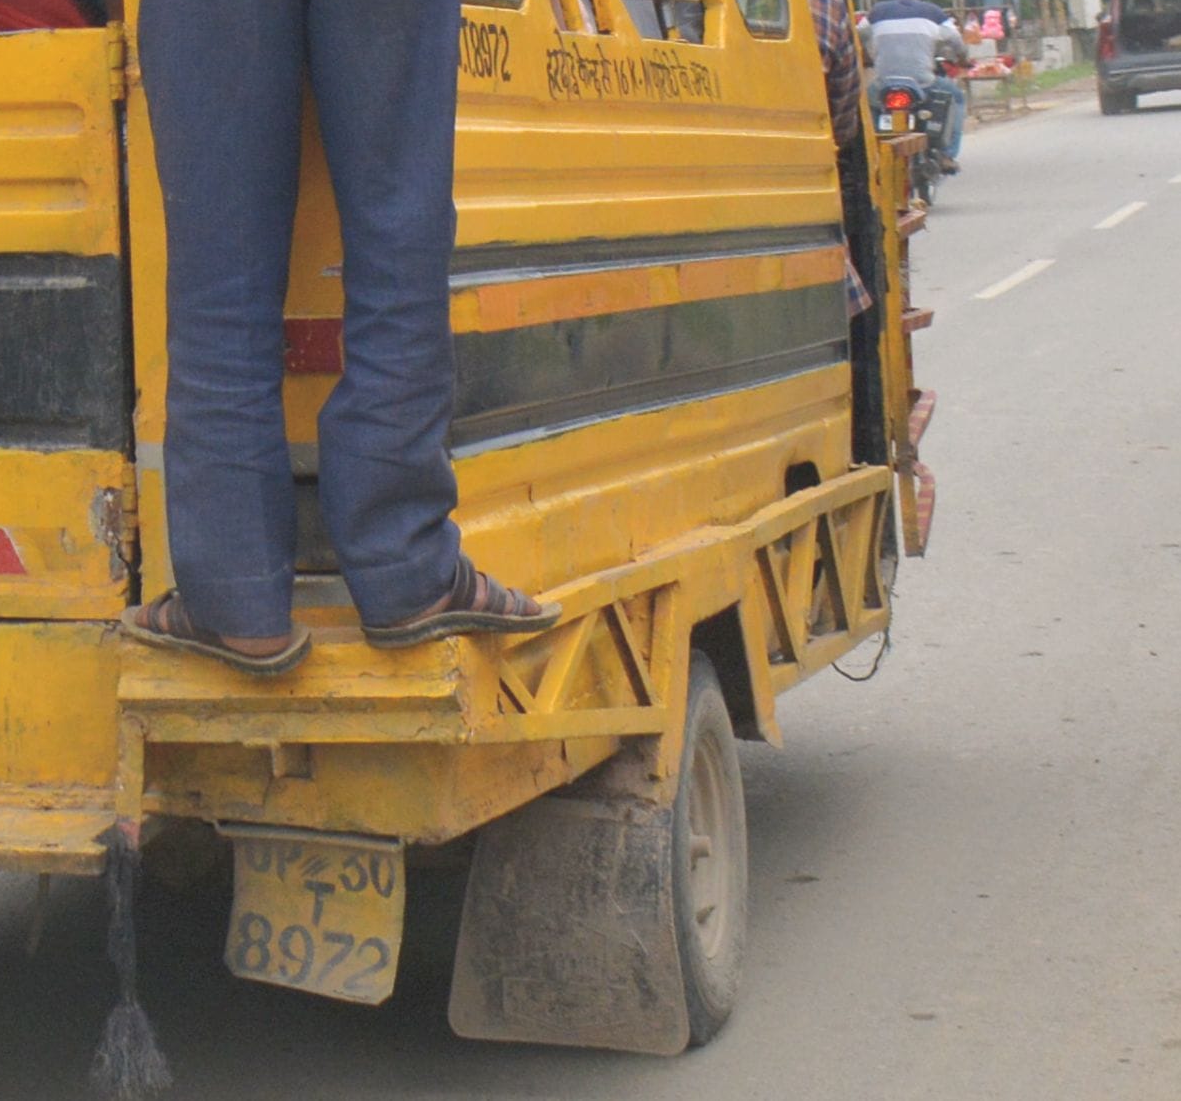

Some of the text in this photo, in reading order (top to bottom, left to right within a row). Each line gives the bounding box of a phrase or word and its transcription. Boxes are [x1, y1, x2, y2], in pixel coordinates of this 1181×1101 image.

[614, 59, 629, 96] 16
[304, 879, 336, 927] T
[235, 911, 392, 991] 8972
